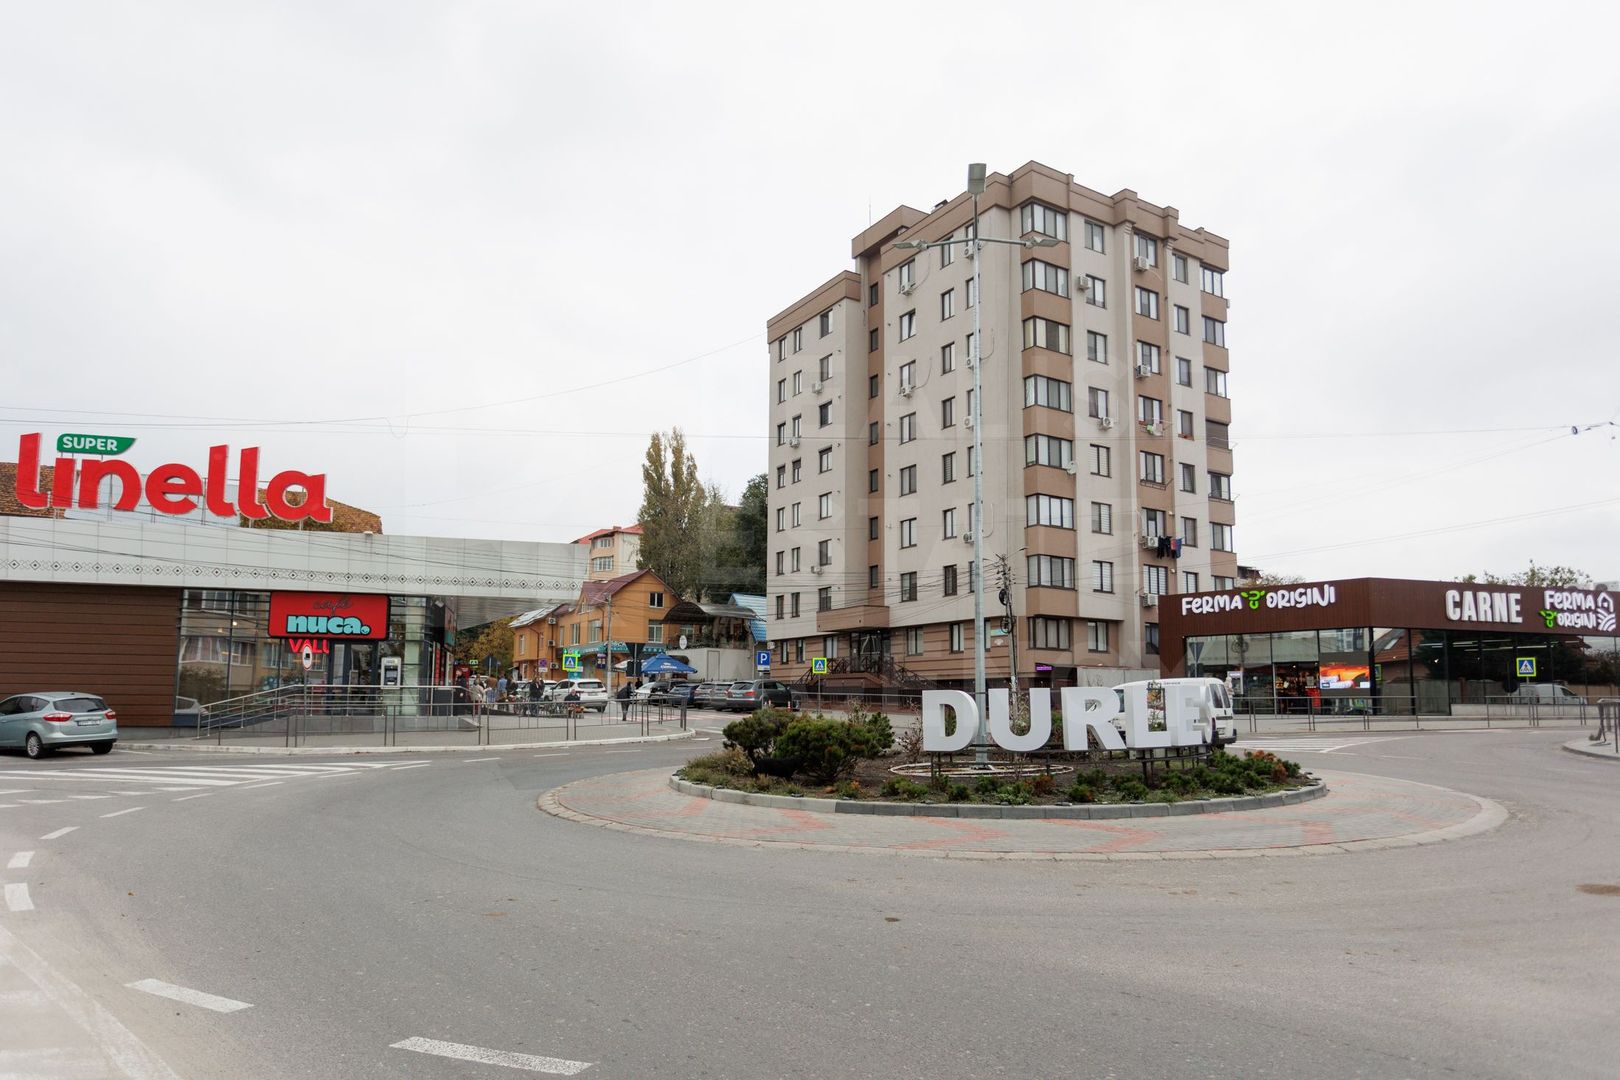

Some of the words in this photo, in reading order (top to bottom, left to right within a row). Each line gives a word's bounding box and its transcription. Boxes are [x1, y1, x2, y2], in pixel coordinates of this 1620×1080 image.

[62, 436, 118, 451] SUPER
[16, 432, 334, 524] linella
[1265, 584, 1336, 610] ORIGINI
[1445, 589, 1523, 624] CARNE
[1556, 611, 1597, 630] ORIGINI
[760, 653, 768, 664] P
